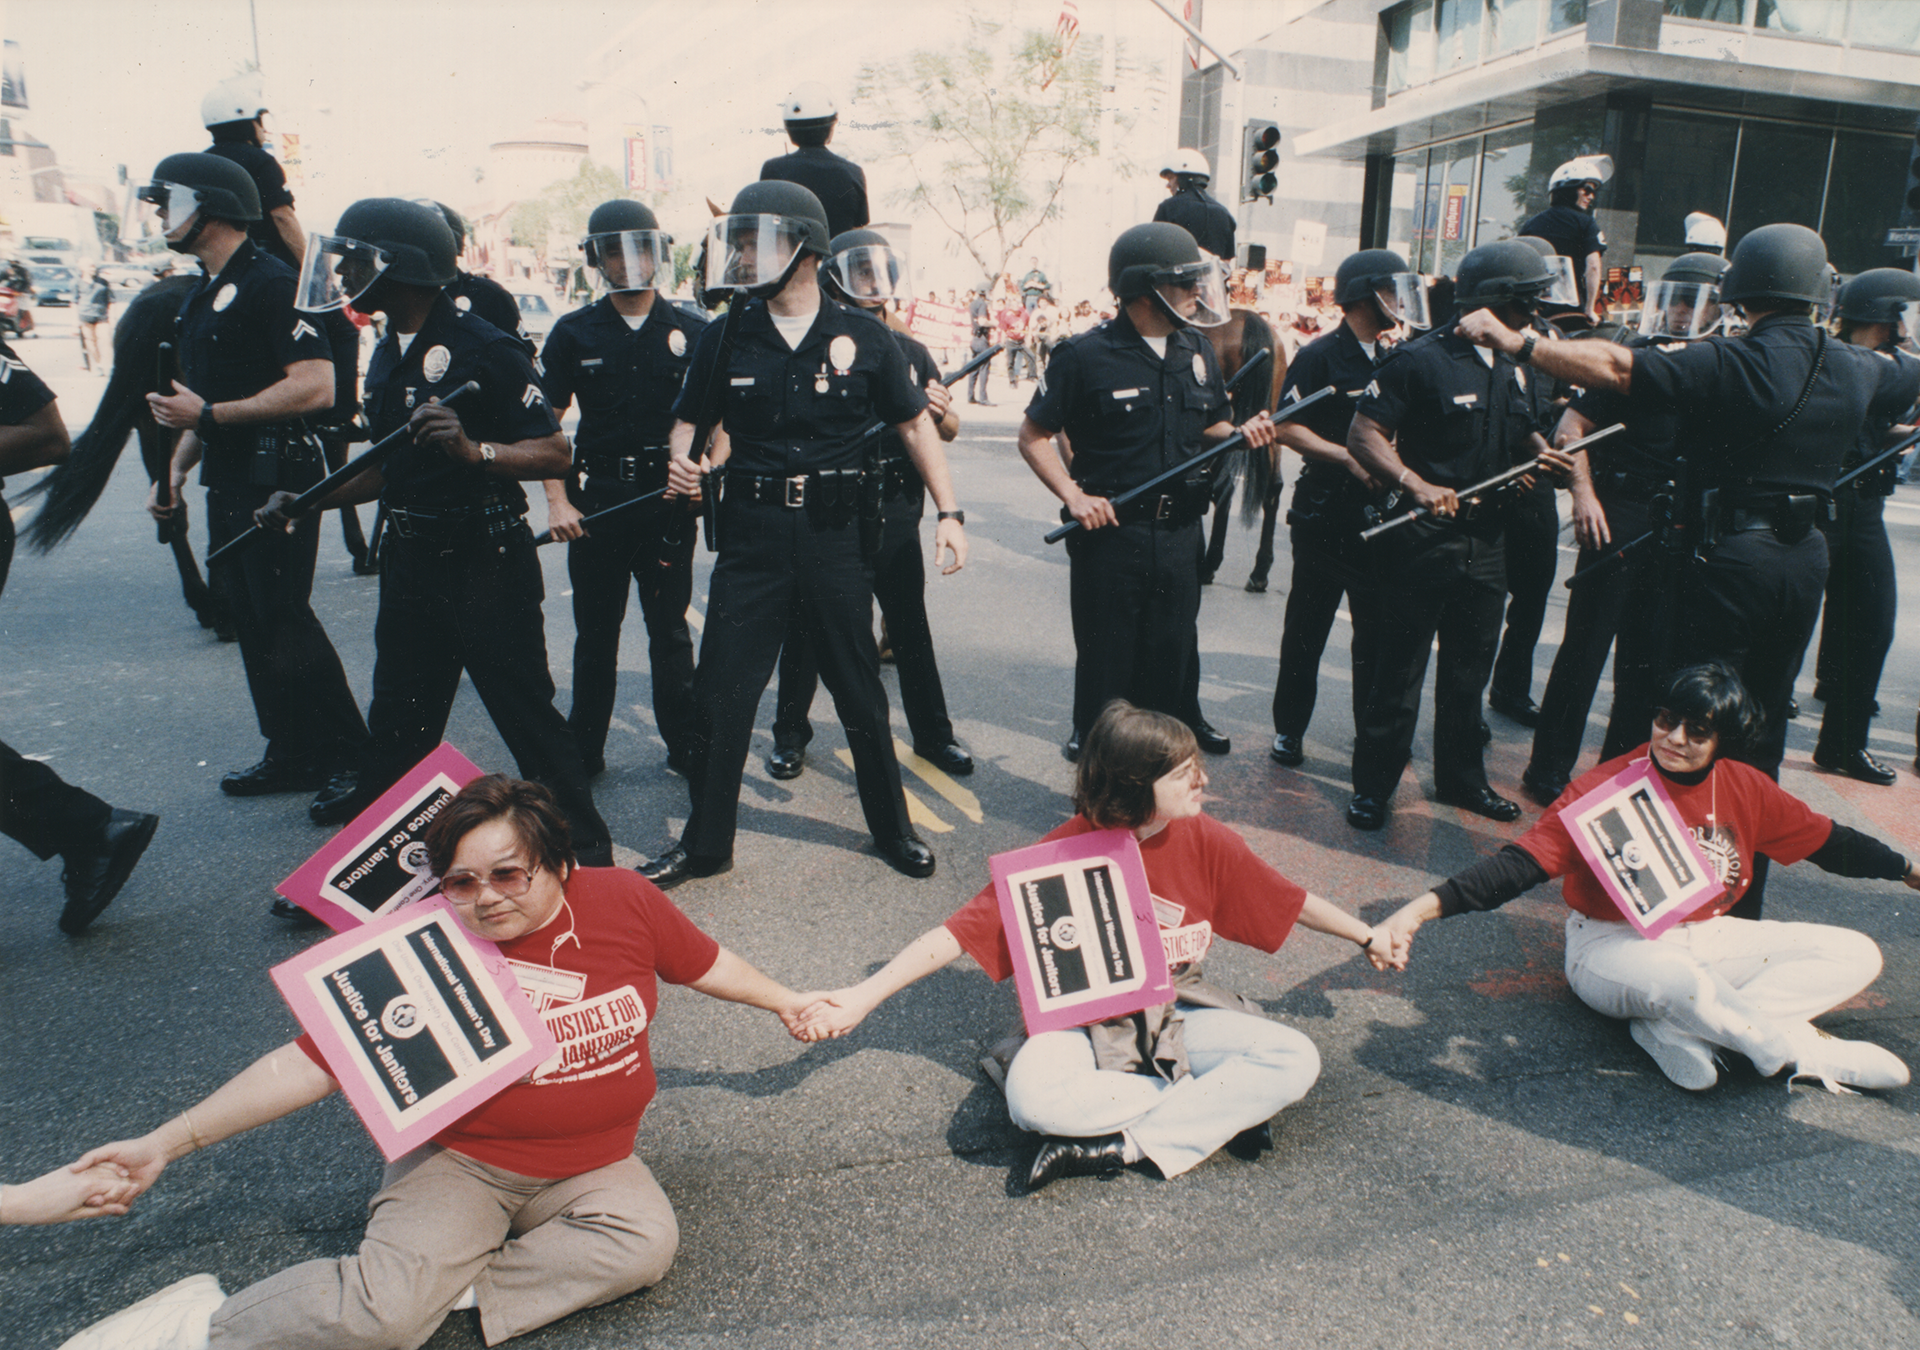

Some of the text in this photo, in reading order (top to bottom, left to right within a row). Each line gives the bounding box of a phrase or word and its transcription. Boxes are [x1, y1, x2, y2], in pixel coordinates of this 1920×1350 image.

[338, 793, 451, 890] Justice for Janitors
[1590, 820, 1650, 913] Justice for Janitors
[1688, 826, 1705, 841] OR
[1025, 881, 1061, 997] Justice for Janitors
[1093, 871, 1124, 977] International Women's Day
[1163, 932, 1190, 960] STICE
[332, 971, 418, 1105] Justice for Janitors
[420, 931, 496, 1049] International Women's Day
[606, 994, 641, 1027] FOR
